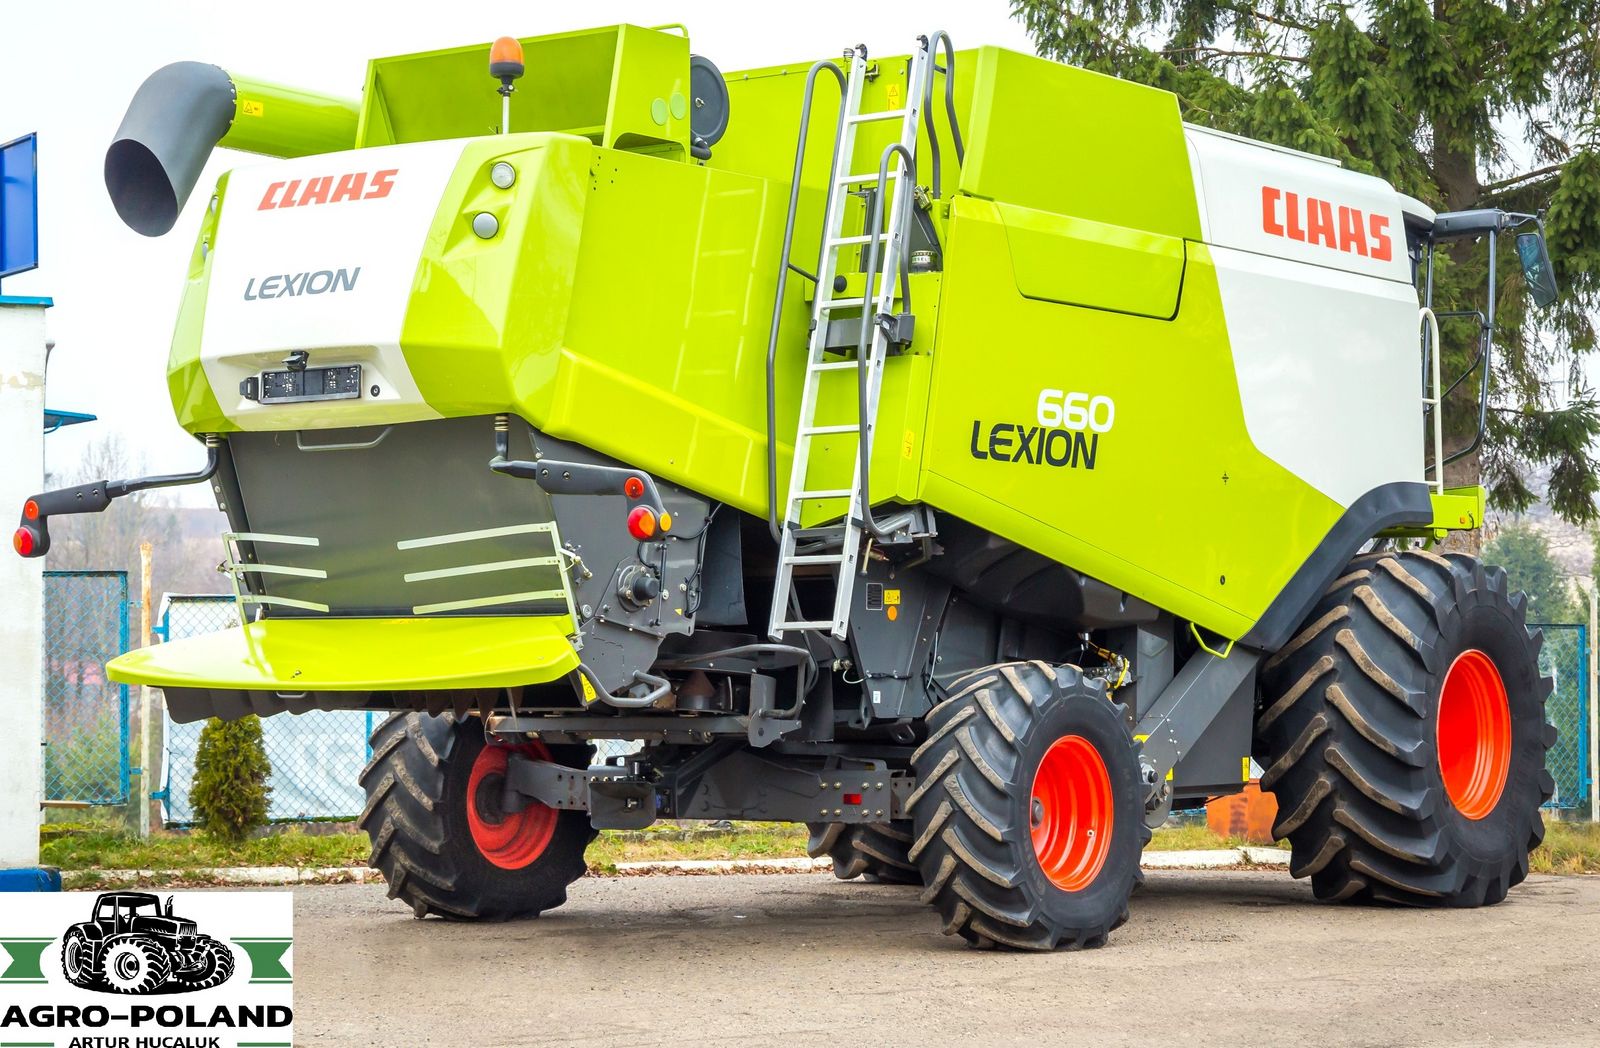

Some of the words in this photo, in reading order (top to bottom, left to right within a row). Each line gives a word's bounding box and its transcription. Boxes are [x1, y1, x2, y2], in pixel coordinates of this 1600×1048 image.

[257, 168, 398, 211] CLAAS
[1261, 185, 1393, 262] CLAAS
[243, 266, 361, 302] LEXION
[1036, 388, 1115, 432] 660
[970, 420, 1099, 470] LEXION
